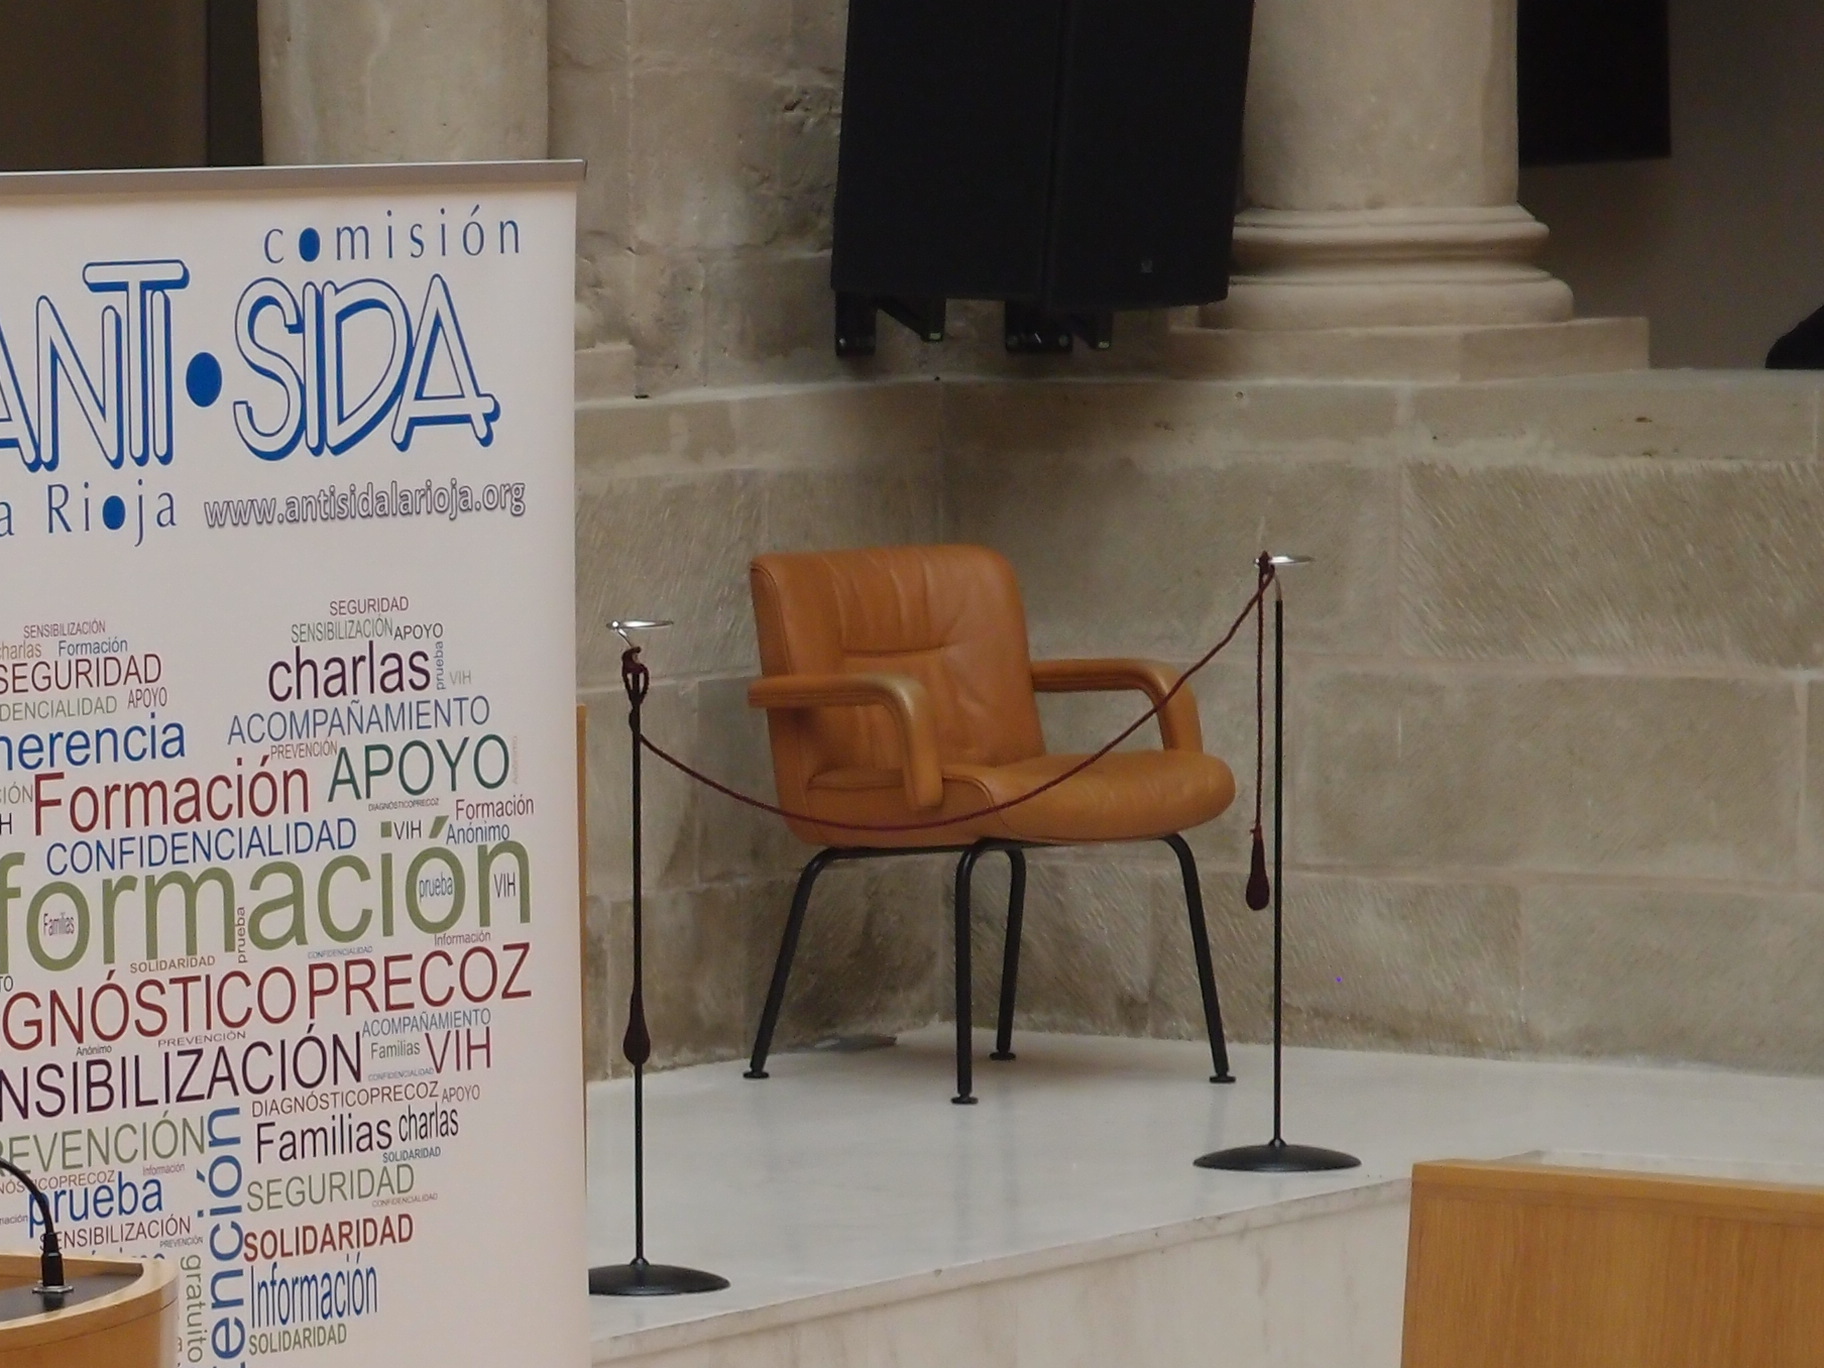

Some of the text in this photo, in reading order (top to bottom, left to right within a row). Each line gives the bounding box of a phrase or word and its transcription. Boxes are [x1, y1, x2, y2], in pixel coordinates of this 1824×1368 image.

[263, 204, 522, 264] comisión
[48, 479, 175, 547] Rioja
[204, 479, 526, 527] www.antisidalarioja.org
[330, 596, 409, 616] SEGURIDAD
[24, 619, 106, 640] SENSIBILIZACIÓN
[291, 614, 393, 644] SENSIBILIZACIÓN
[394, 622, 444, 641] APOYO
[58, 637, 128, 657] Formación
[268, 640, 430, 702] charlas
[434, 641, 446, 690] prueba
[450, 670, 472, 686] VIH
[127, 687, 168, 710] APOYO
[228, 696, 490, 746] ACOMPAÑAMIENTO
[328, 734, 510, 802] APOYO
[35, 755, 308, 836] Formación
[456, 794, 534, 820] Formación
[394, 820, 422, 840] VIH
[446, 820, 510, 844] Anónimo
[47, 818, 356, 876] CONFIDENCIALIDAD
[420, 873, 454, 900] prueba
[494, 873, 516, 898] VIH
[235, 907, 248, 963] prueba
[434, 931, 491, 946] Información
[130, 955, 215, 974] SOLIDARIDAD
[362, 1008, 491, 1038] ACOMPAÑAMIENTO
[158, 1030, 246, 1048] PREVENCIÓN
[370, 1040, 420, 1060] Familias
[426, 1026, 491, 1073] VIH
[442, 1084, 480, 1102] APOYO
[399, 1102, 458, 1142] charlas
[256, 1113, 392, 1164] Familias
[383, 1146, 441, 1163] SOLIDARIDAD
[247, 1163, 414, 1212] SEGURIDAD
[28, 1171, 162, 1238] prueba
[244, 1213, 413, 1262] SOLIDARIDAD
[250, 1252, 377, 1328] Información
[181, 1255, 207, 1363] gratuito
[249, 1323, 346, 1356] SOLIDARIDAD
